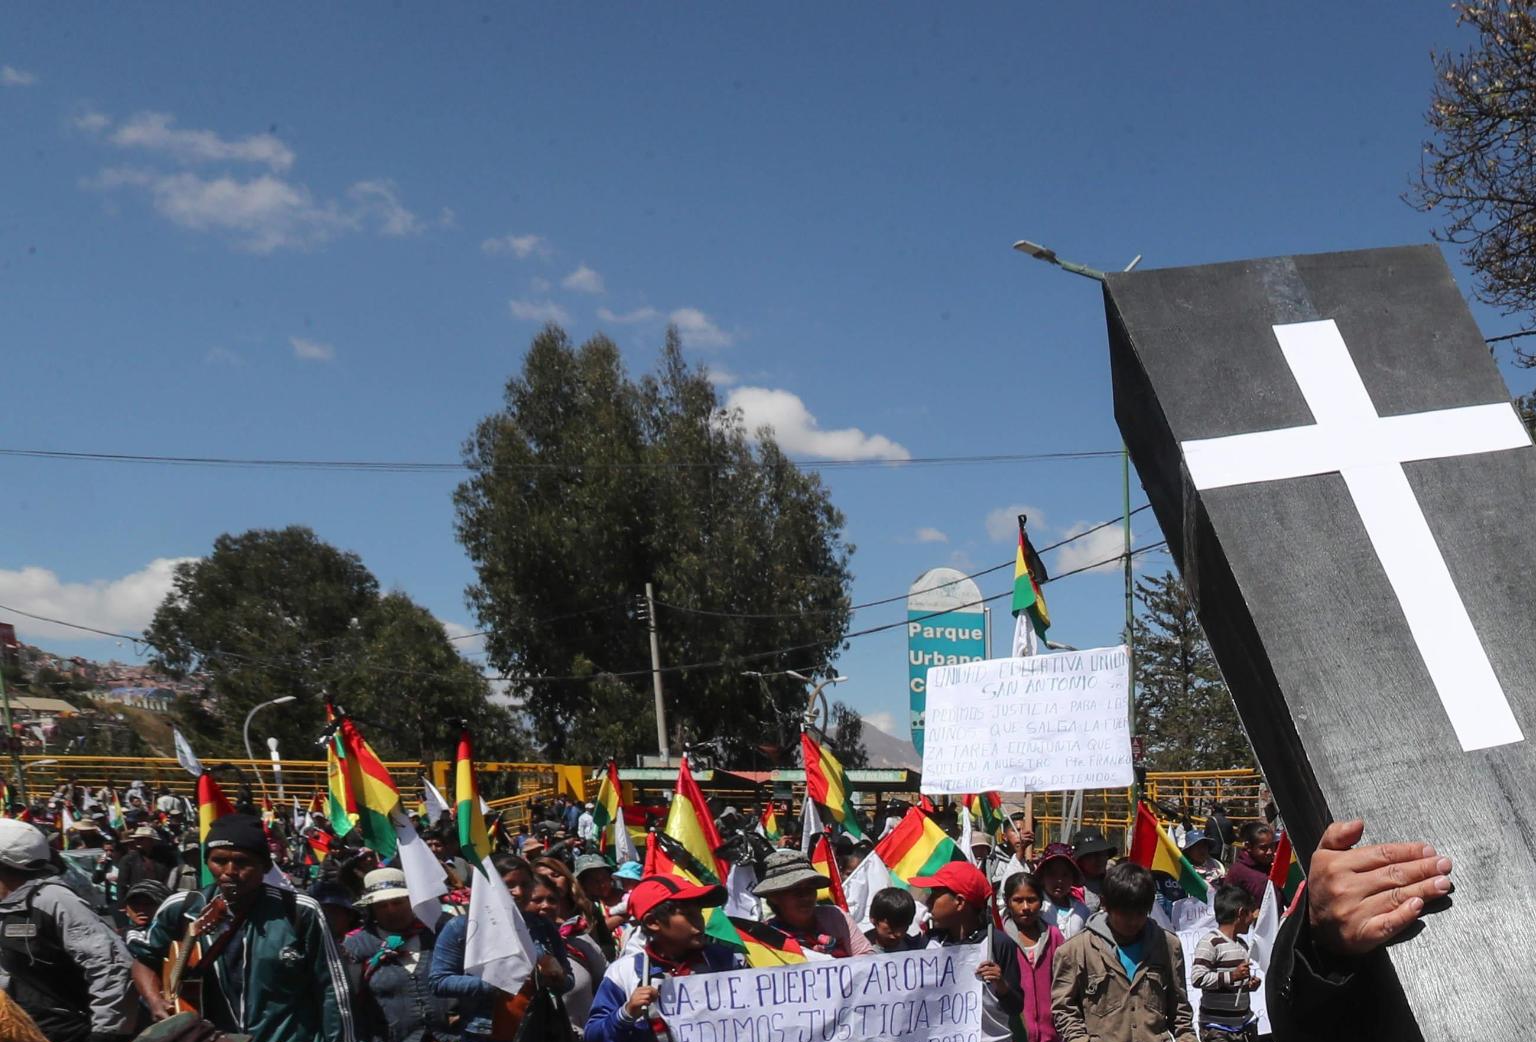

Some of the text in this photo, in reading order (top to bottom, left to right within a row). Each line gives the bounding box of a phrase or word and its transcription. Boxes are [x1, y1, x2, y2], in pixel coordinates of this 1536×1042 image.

[909, 622, 983, 642] Parque
[1024, 675, 1097, 694] ANTONIO
[991, 702, 1058, 719] JUSTICIA
[1088, 737, 1112, 752] QUE
[704, 976, 751, 1011] U.E.
[756, 964, 853, 1007] PUERTO
[862, 955, 957, 995] AROMA
[939, 990, 979, 1025] POR
